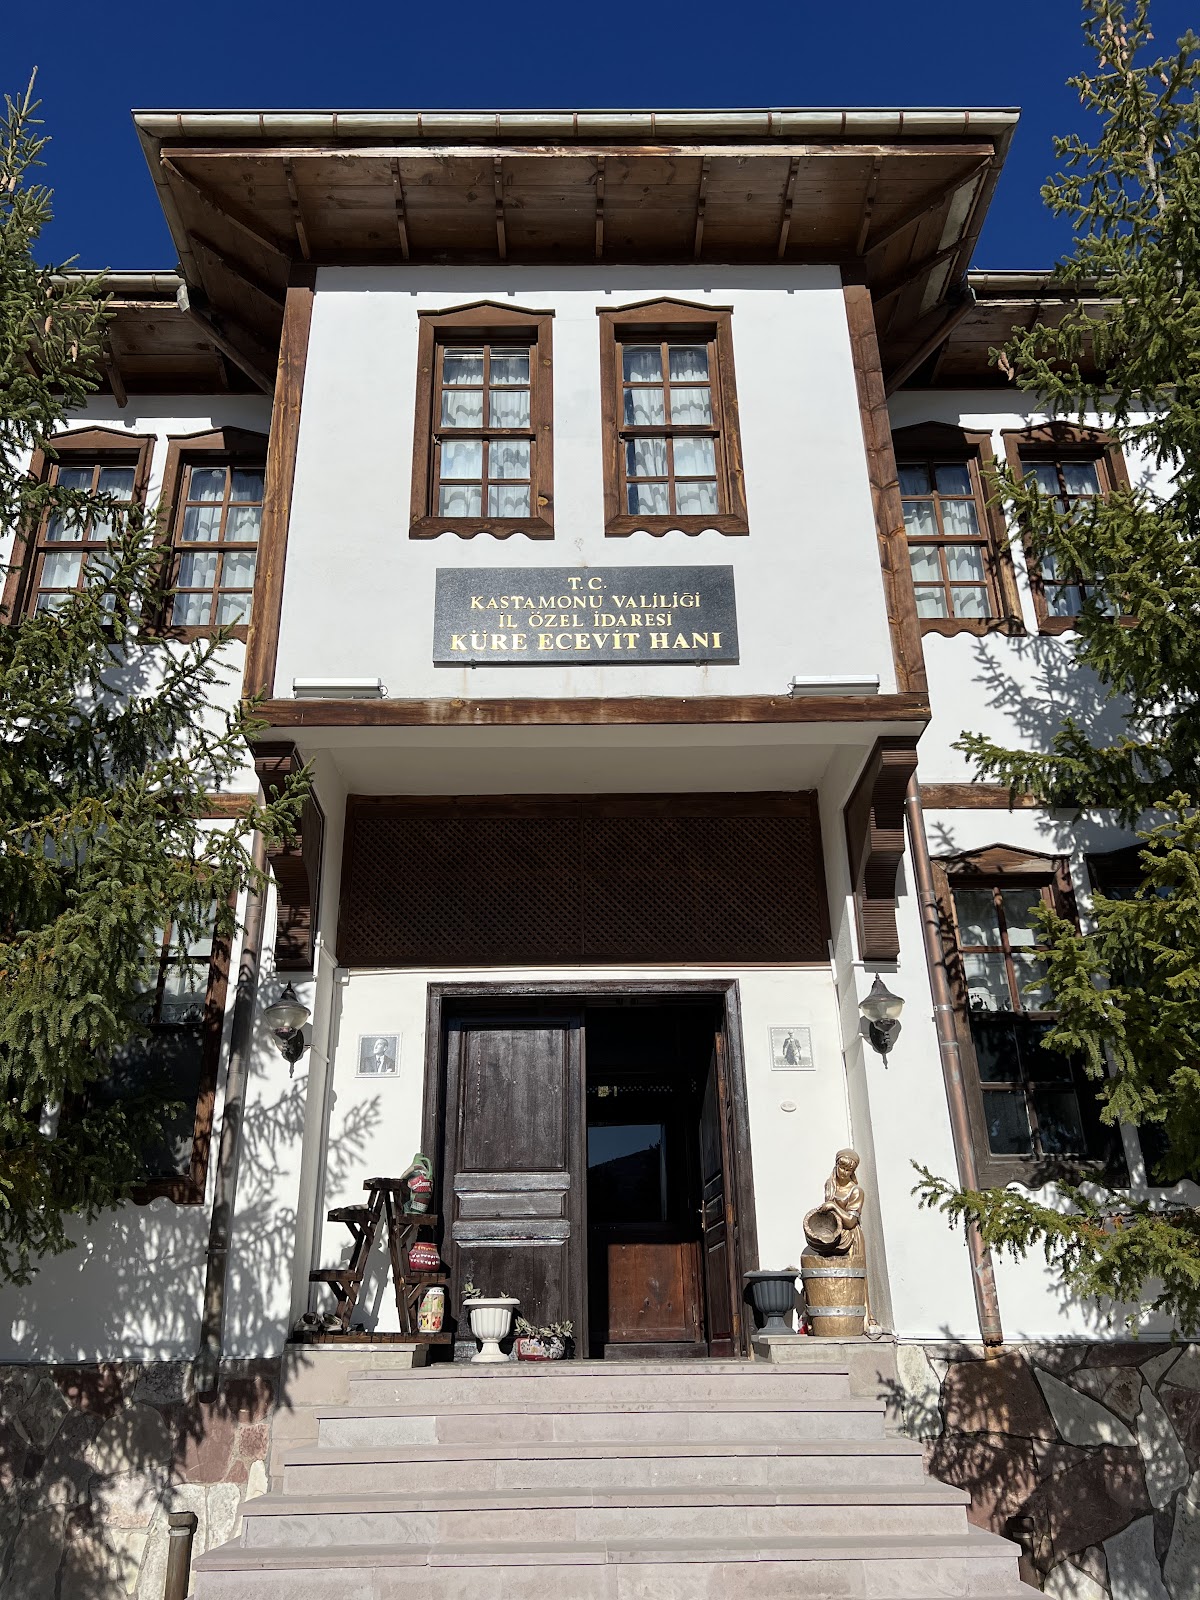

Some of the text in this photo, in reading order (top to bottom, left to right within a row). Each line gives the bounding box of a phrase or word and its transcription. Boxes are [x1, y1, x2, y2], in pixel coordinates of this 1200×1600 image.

[470, 591, 702, 610] KASTAMONU VALİLİĞİ
[498, 610, 673, 629] İL ÖZEL İDARESİ
[450, 628, 723, 652] KÜRE ECEVİT HANI
